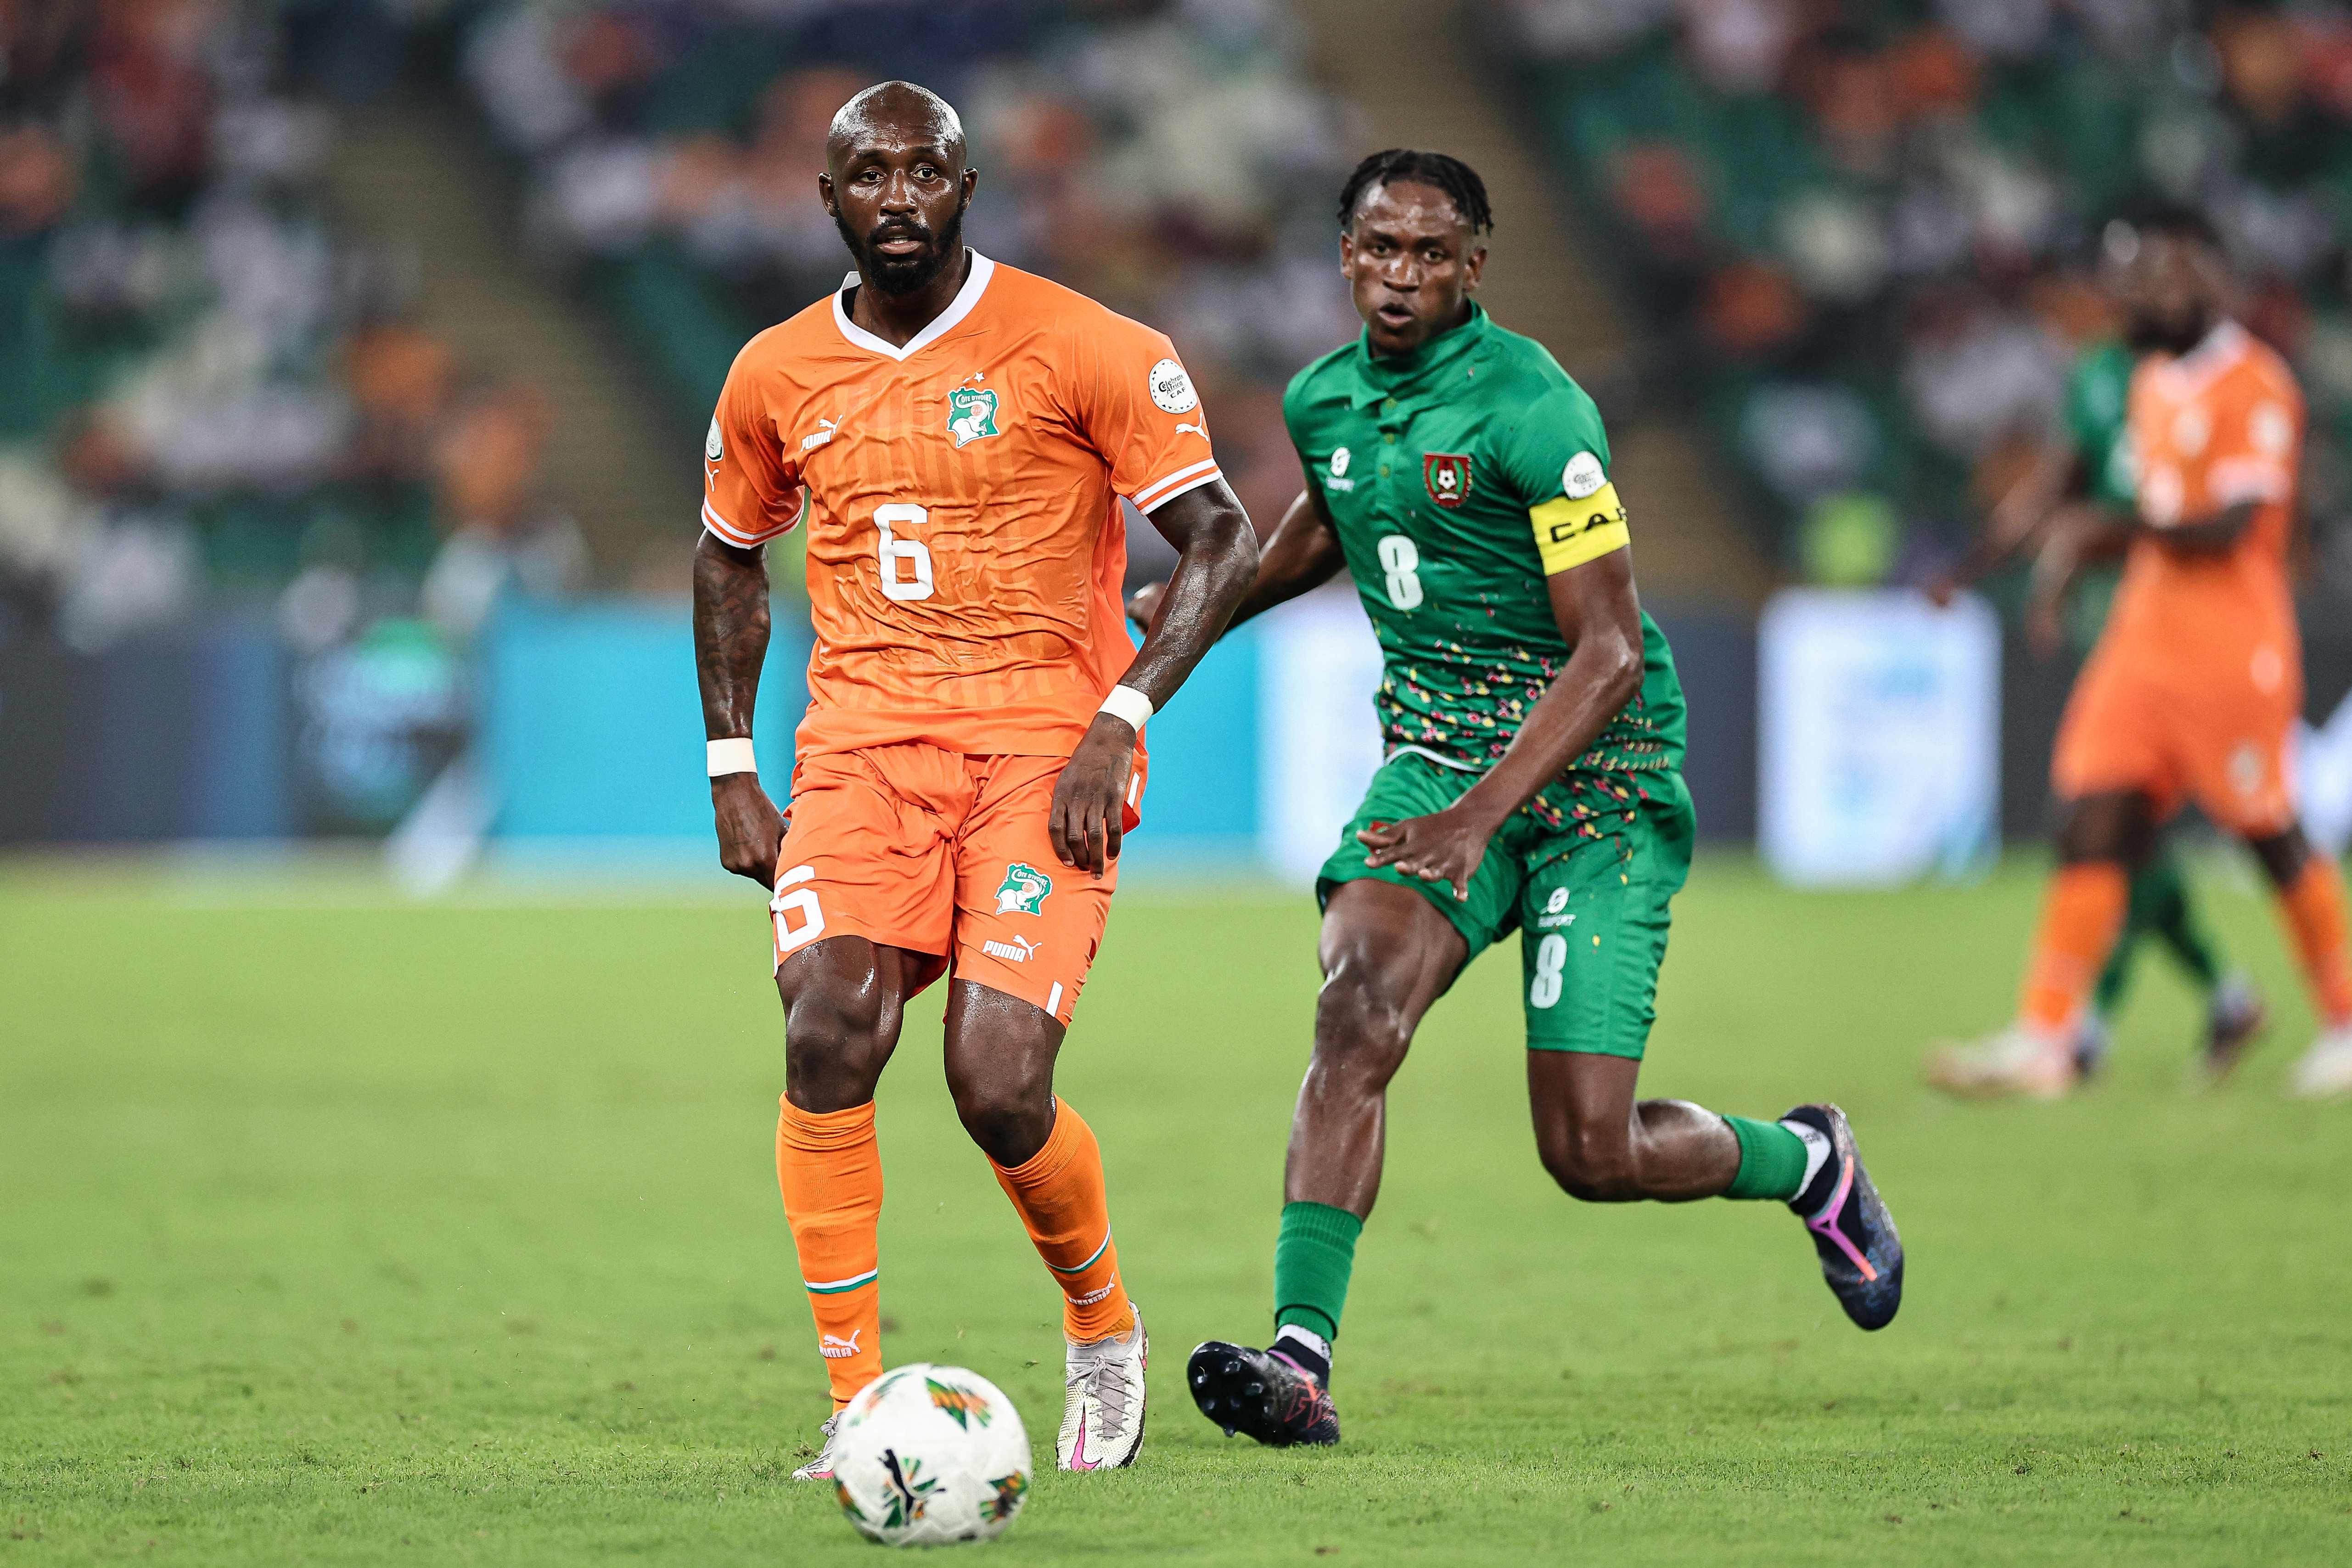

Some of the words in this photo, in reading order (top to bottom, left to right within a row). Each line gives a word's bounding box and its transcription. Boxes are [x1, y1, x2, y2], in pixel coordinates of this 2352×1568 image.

[1158, 374, 1184, 392] Celebrate
[1167, 381, 1183, 394] Africa
[1170, 387, 1186, 398] CAF
[800, 429, 832, 452] PUMA
[873, 504, 935, 601] 6
[1377, 534, 1424, 610] 8
[769, 865, 825, 952] 6
[982, 940, 1027, 963] PUMA
[1530, 933, 1567, 1008] 8
[1068, 1288, 1110, 1306] PUMA
